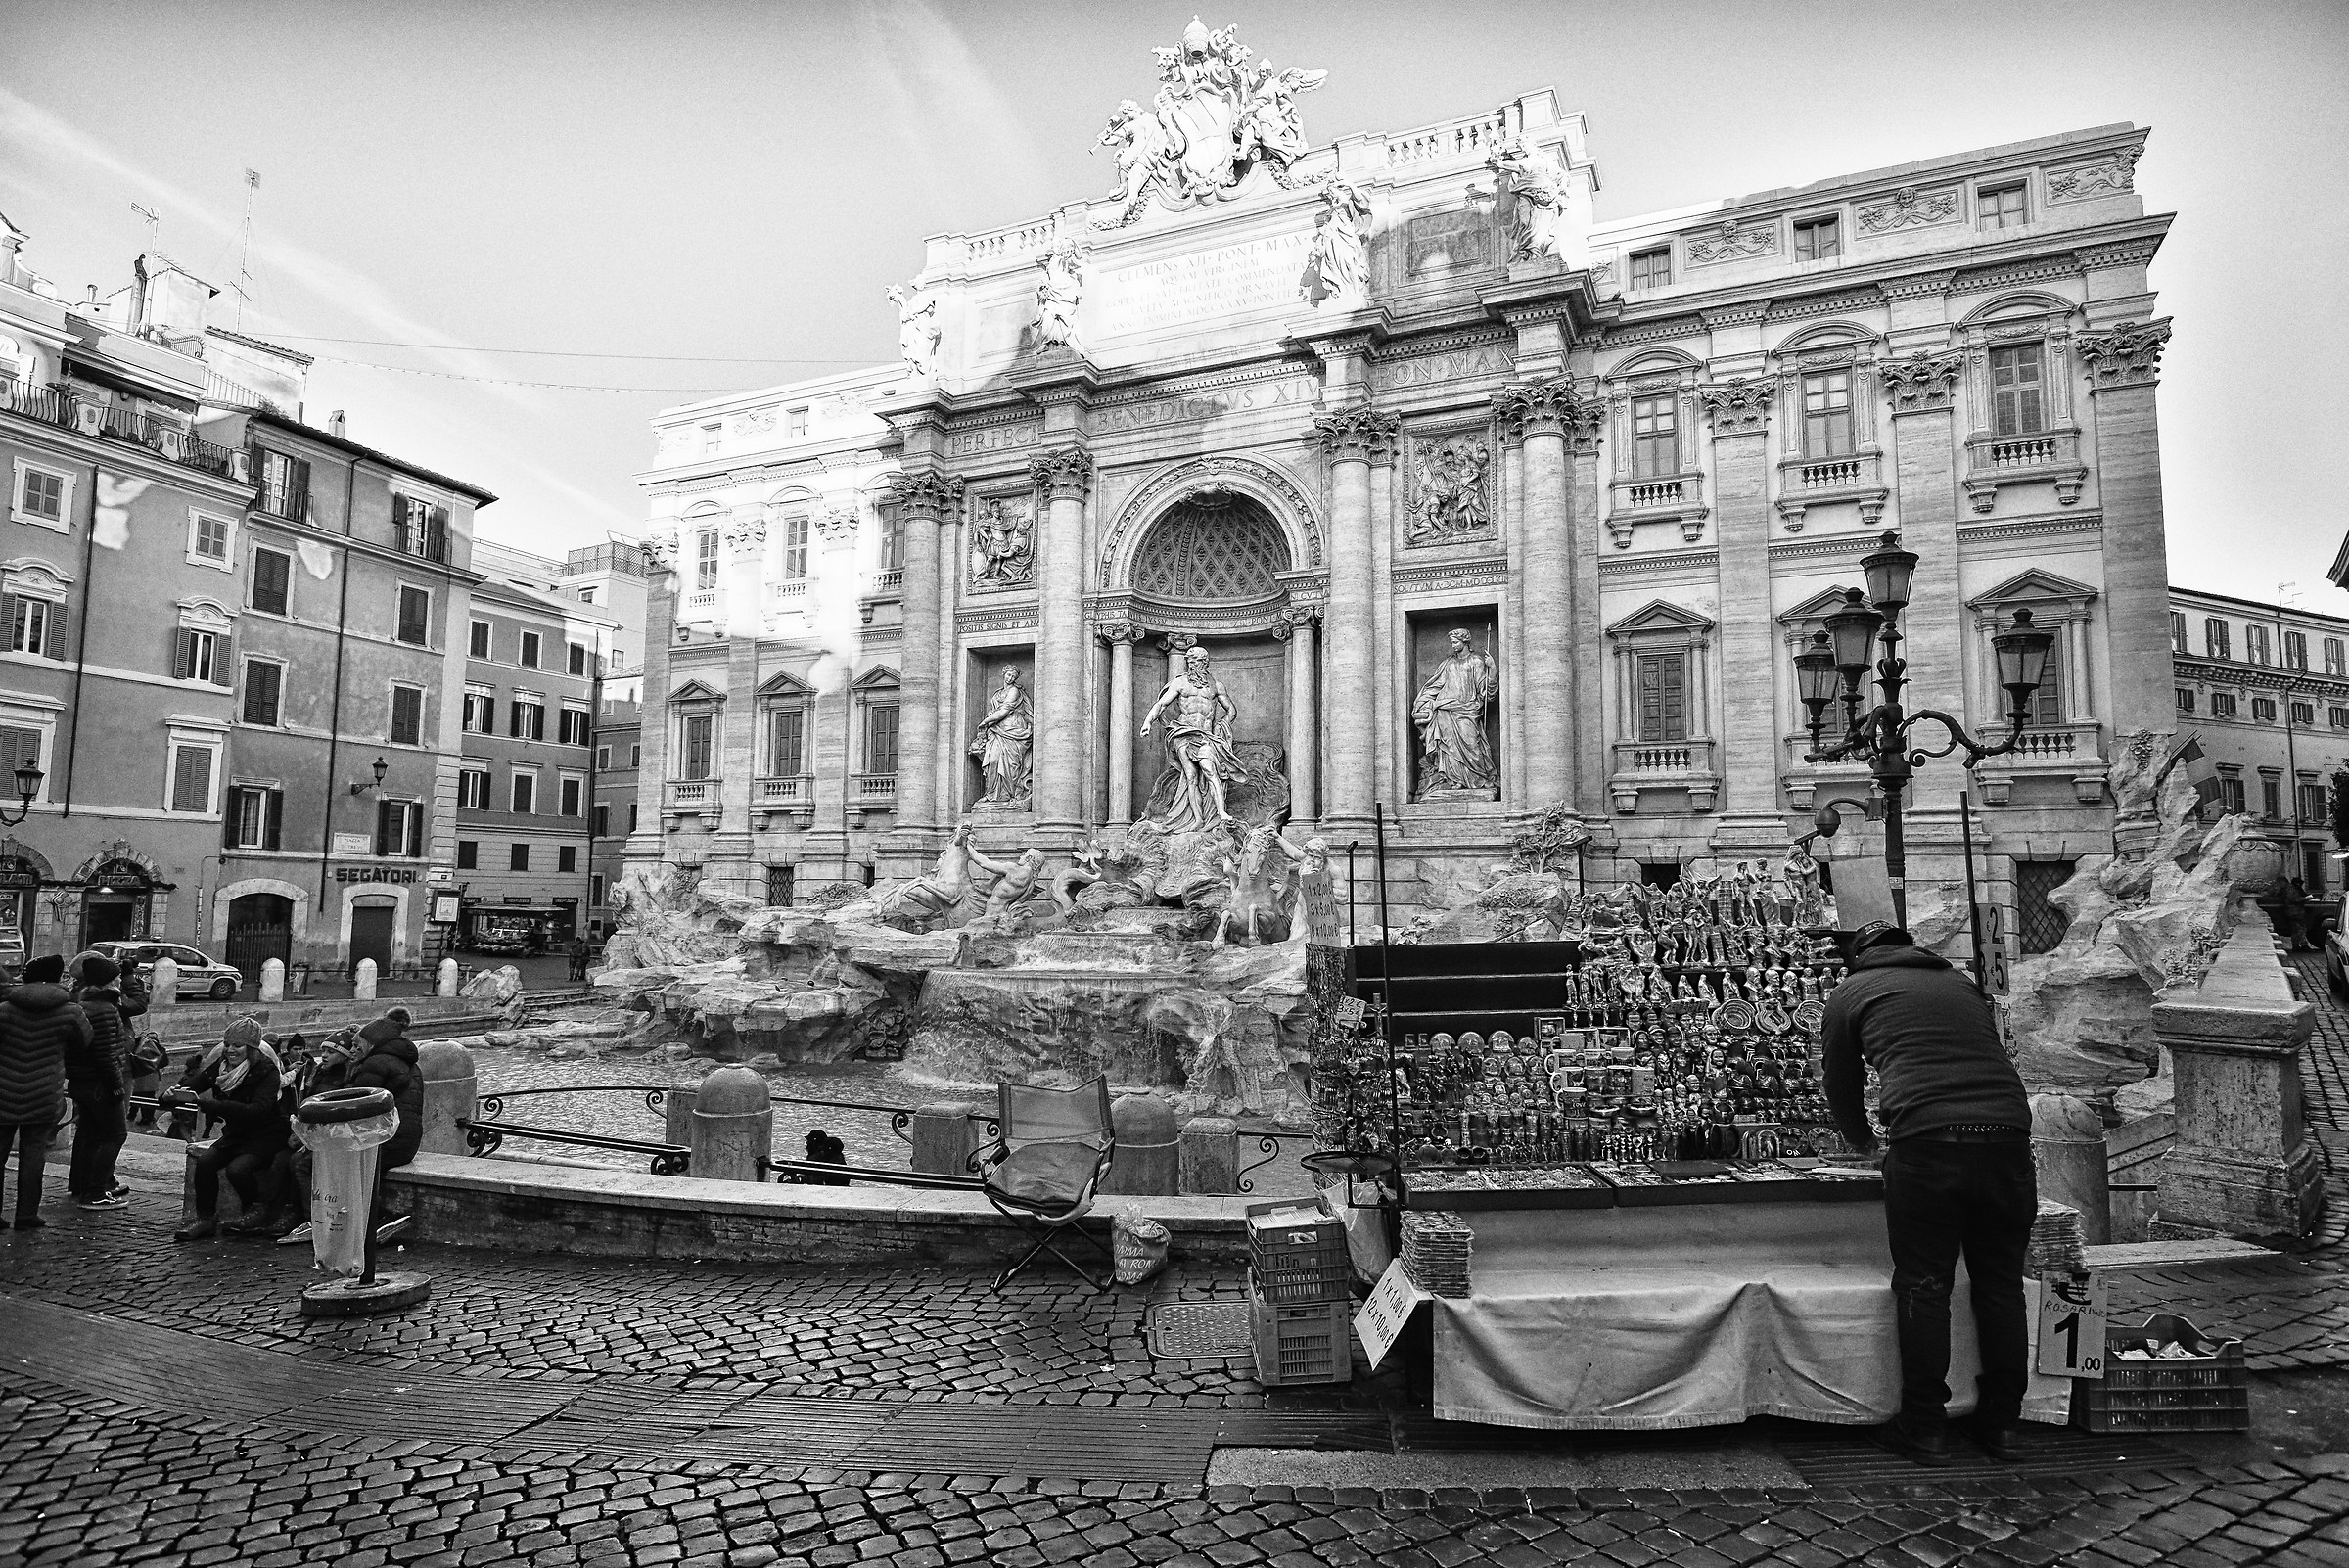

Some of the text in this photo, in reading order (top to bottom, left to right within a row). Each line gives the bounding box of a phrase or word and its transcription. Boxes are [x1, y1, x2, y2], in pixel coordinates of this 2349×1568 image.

[1118, 262, 1178, 283] CLEMENS
[1447, 346, 1514, 378] MAX
[1097, 379, 1318, 432] BENEDICTVS XIV
[97, 875, 141, 886] PIZZA
[336, 867, 417, 883] SEGATORI
